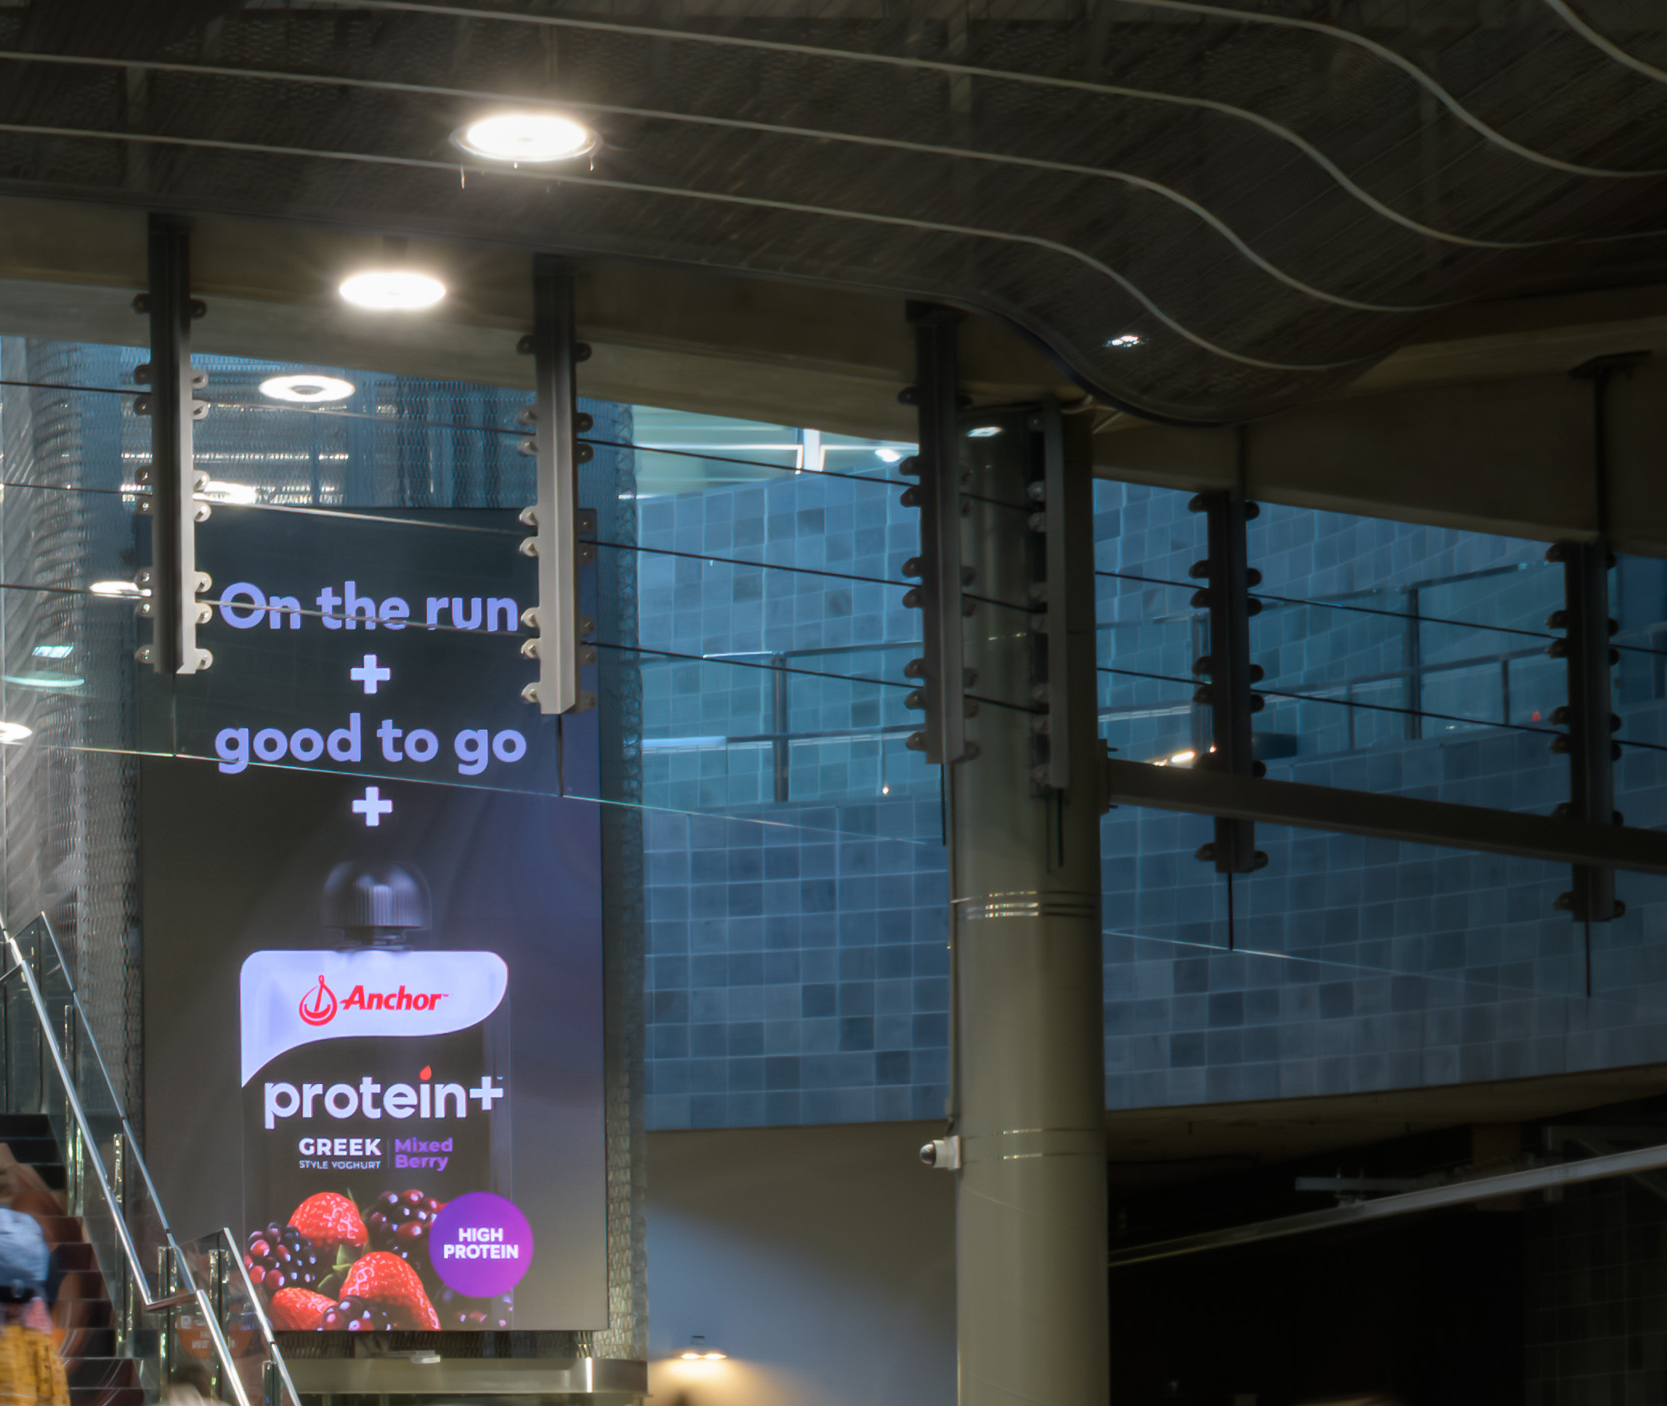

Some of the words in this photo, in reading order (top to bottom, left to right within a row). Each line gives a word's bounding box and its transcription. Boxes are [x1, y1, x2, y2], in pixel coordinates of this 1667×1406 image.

[219, 581, 301, 630] On
[315, 580, 410, 631] the
[425, 596, 518, 632] run
[214, 712, 361, 775] good
[376, 719, 439, 763] to
[454, 728, 527, 775] go
[339, 985, 443, 1012] Anchor
[264, 1064, 504, 1130] protein+
[299, 1138, 382, 1156] GREEK
[394, 1137, 453, 1153] Mixed
[299, 1160, 329, 1170] STYLE
[331, 1160, 382, 1170] YOGHURT
[394, 1154, 449, 1171] Berry
[458, 1227, 503, 1242] HIGH
[443, 1244, 519, 1260] PROTEIN
